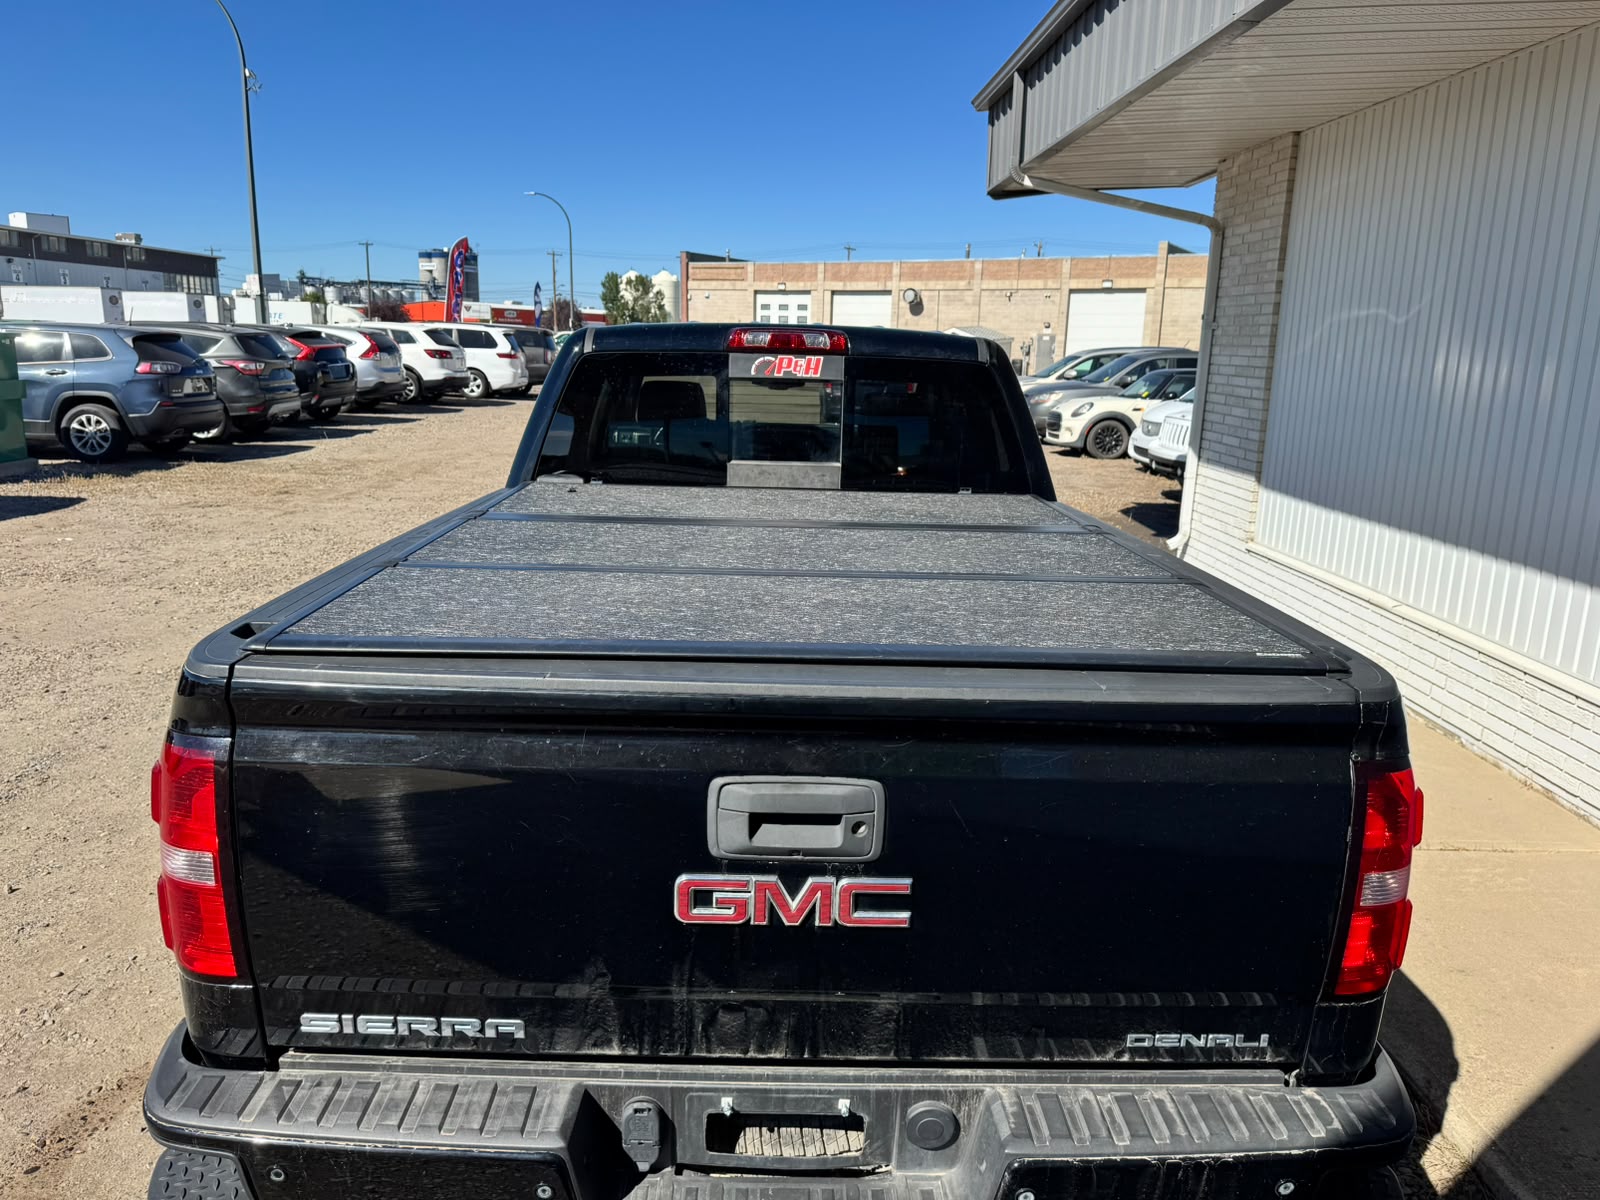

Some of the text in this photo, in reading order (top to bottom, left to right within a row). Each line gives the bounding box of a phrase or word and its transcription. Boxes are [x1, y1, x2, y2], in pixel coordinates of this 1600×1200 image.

[774, 355, 823, 377] P&H
[674, 873, 913, 928] GMC
[300, 1012, 526, 1039] SIERRA
[1126, 1033, 1270, 1048] DENALI
